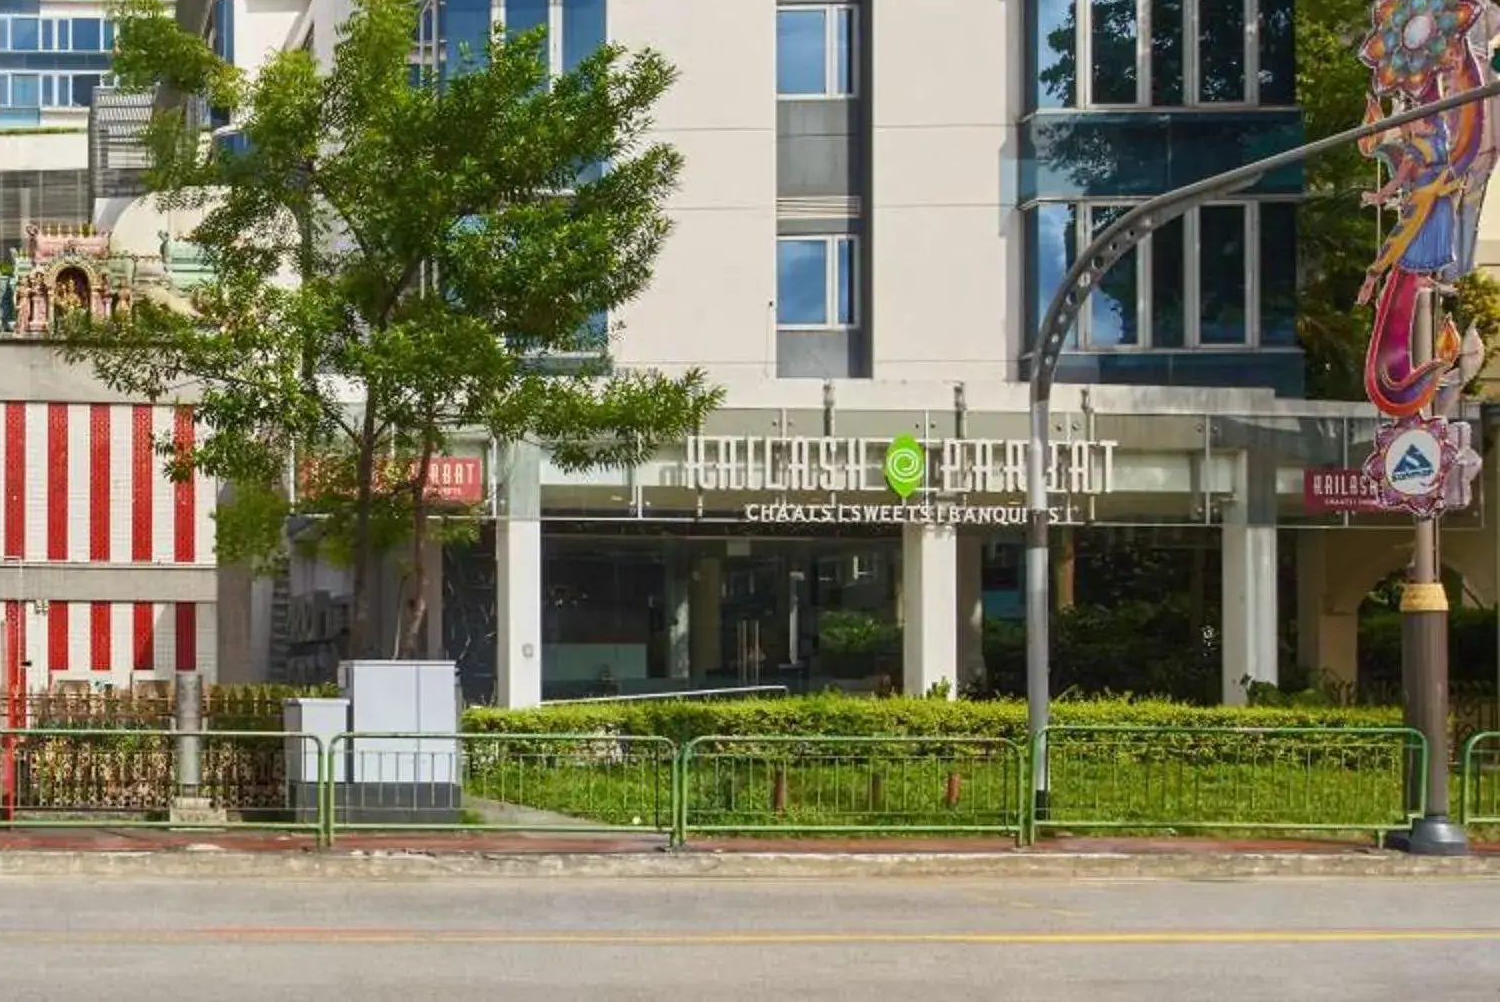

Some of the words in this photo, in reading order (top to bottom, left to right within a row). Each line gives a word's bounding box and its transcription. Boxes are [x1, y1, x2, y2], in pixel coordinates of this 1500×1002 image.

[747, 503, 833, 523] CHAATS
[852, 504, 931, 524] SWEETS
[950, 506, 1060, 524] BANQUS
